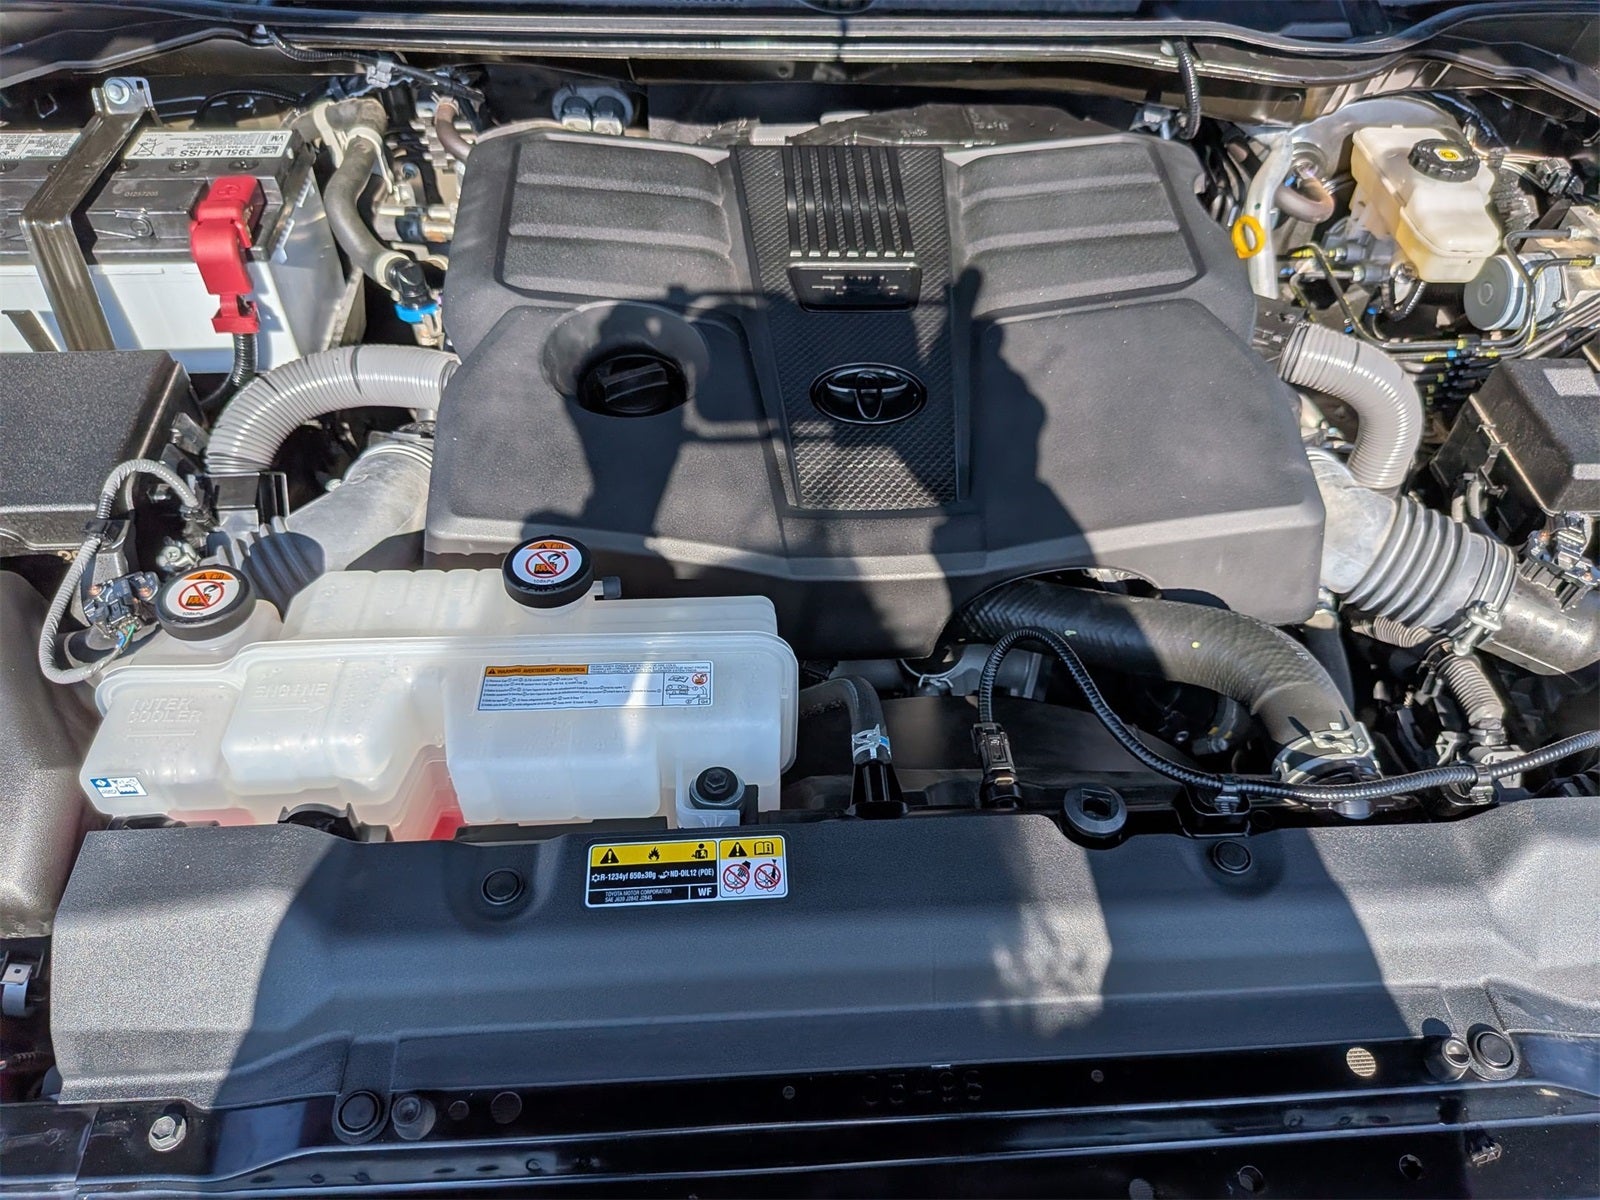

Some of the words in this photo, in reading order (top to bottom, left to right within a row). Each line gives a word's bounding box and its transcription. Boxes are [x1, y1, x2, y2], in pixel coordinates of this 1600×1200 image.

[179, 148, 254, 157] 395LN4-ISS
[254, 683, 328, 698] ENGINE
[127, 709, 202, 723] COOLER
[600, 873, 629, 882] R-1234yf
[629, 871, 657, 880] 650±30g
[698, 868, 715, 878] (POE)
[697, 887, 713, 897] WF
